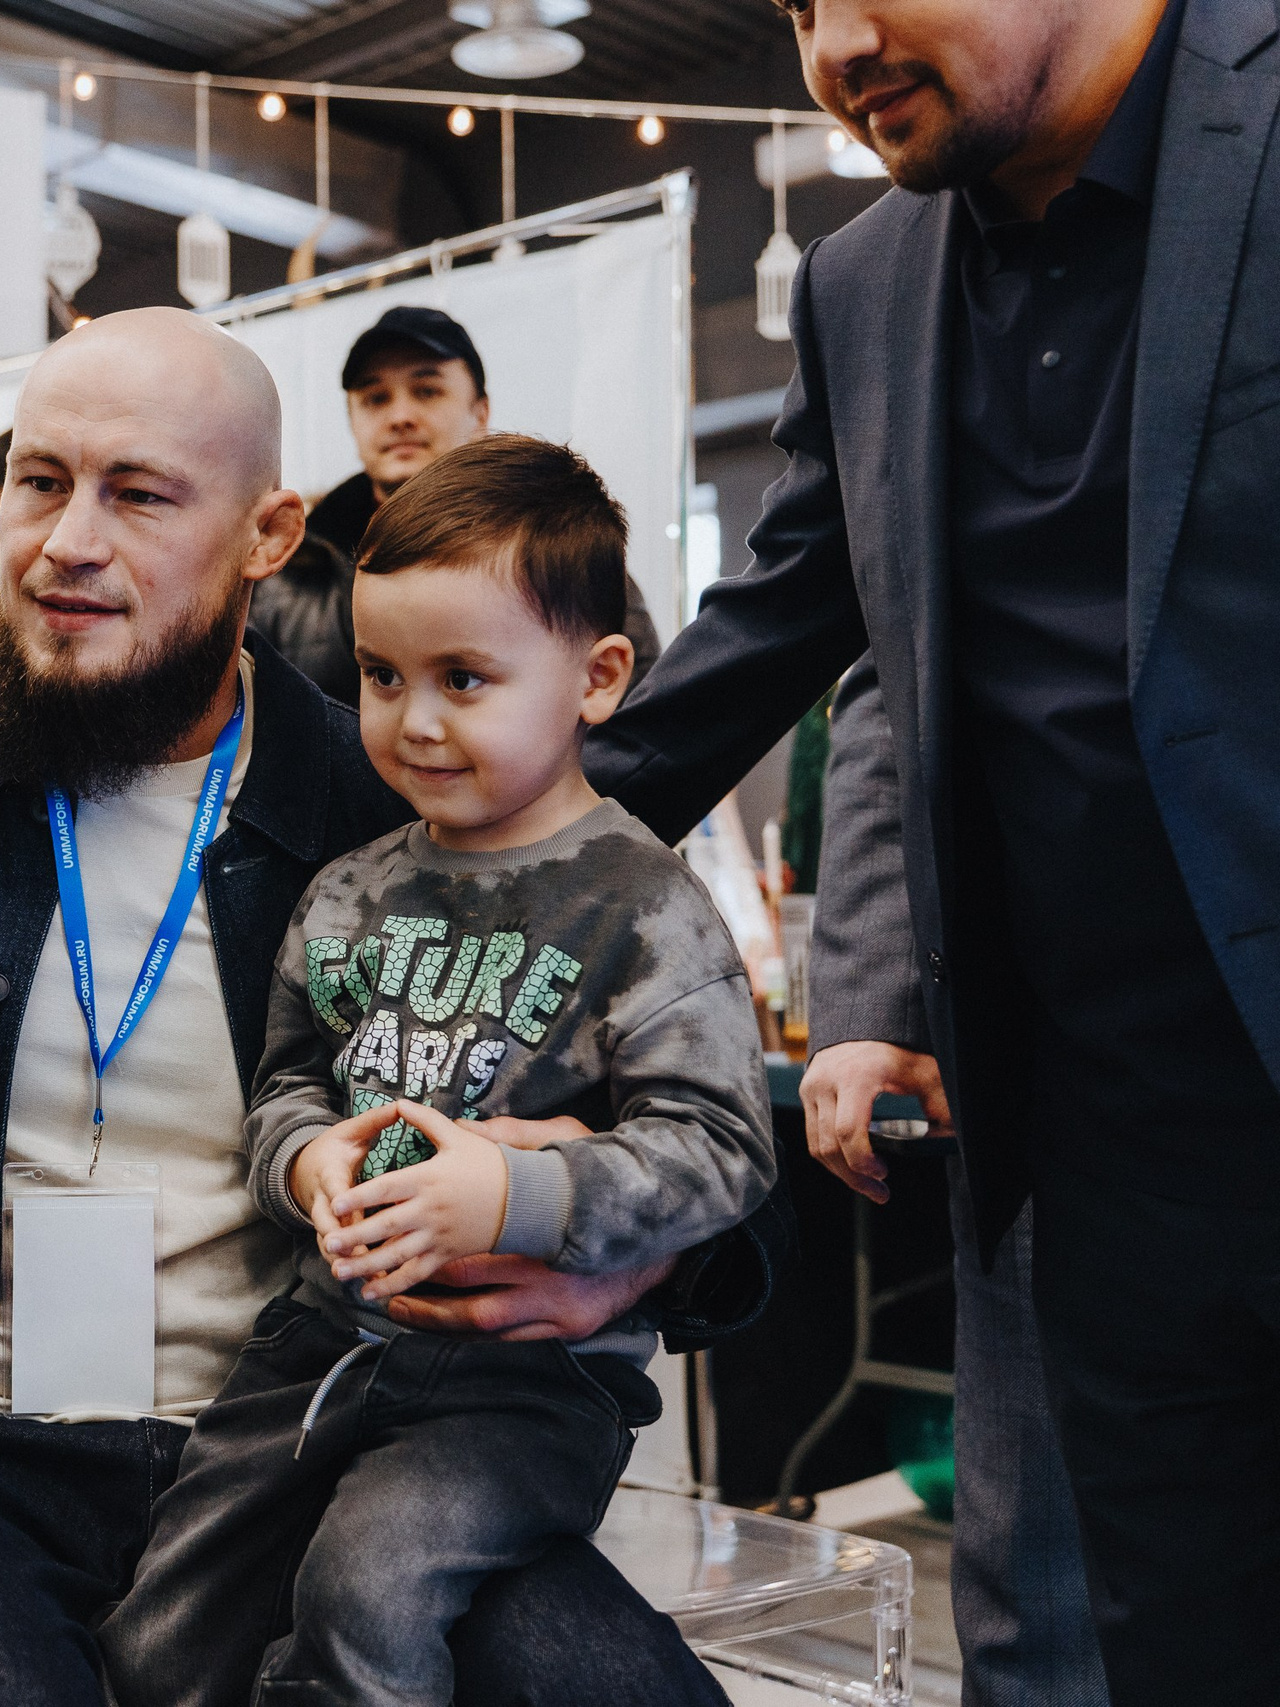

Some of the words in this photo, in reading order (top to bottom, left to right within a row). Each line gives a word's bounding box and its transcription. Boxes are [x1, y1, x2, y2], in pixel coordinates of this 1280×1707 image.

[187, 768, 224, 873] UMMAFORUM.RU
[117, 938, 170, 1039] UMMAFORUM.RU
[332, 1009, 507, 1103] ARTS
